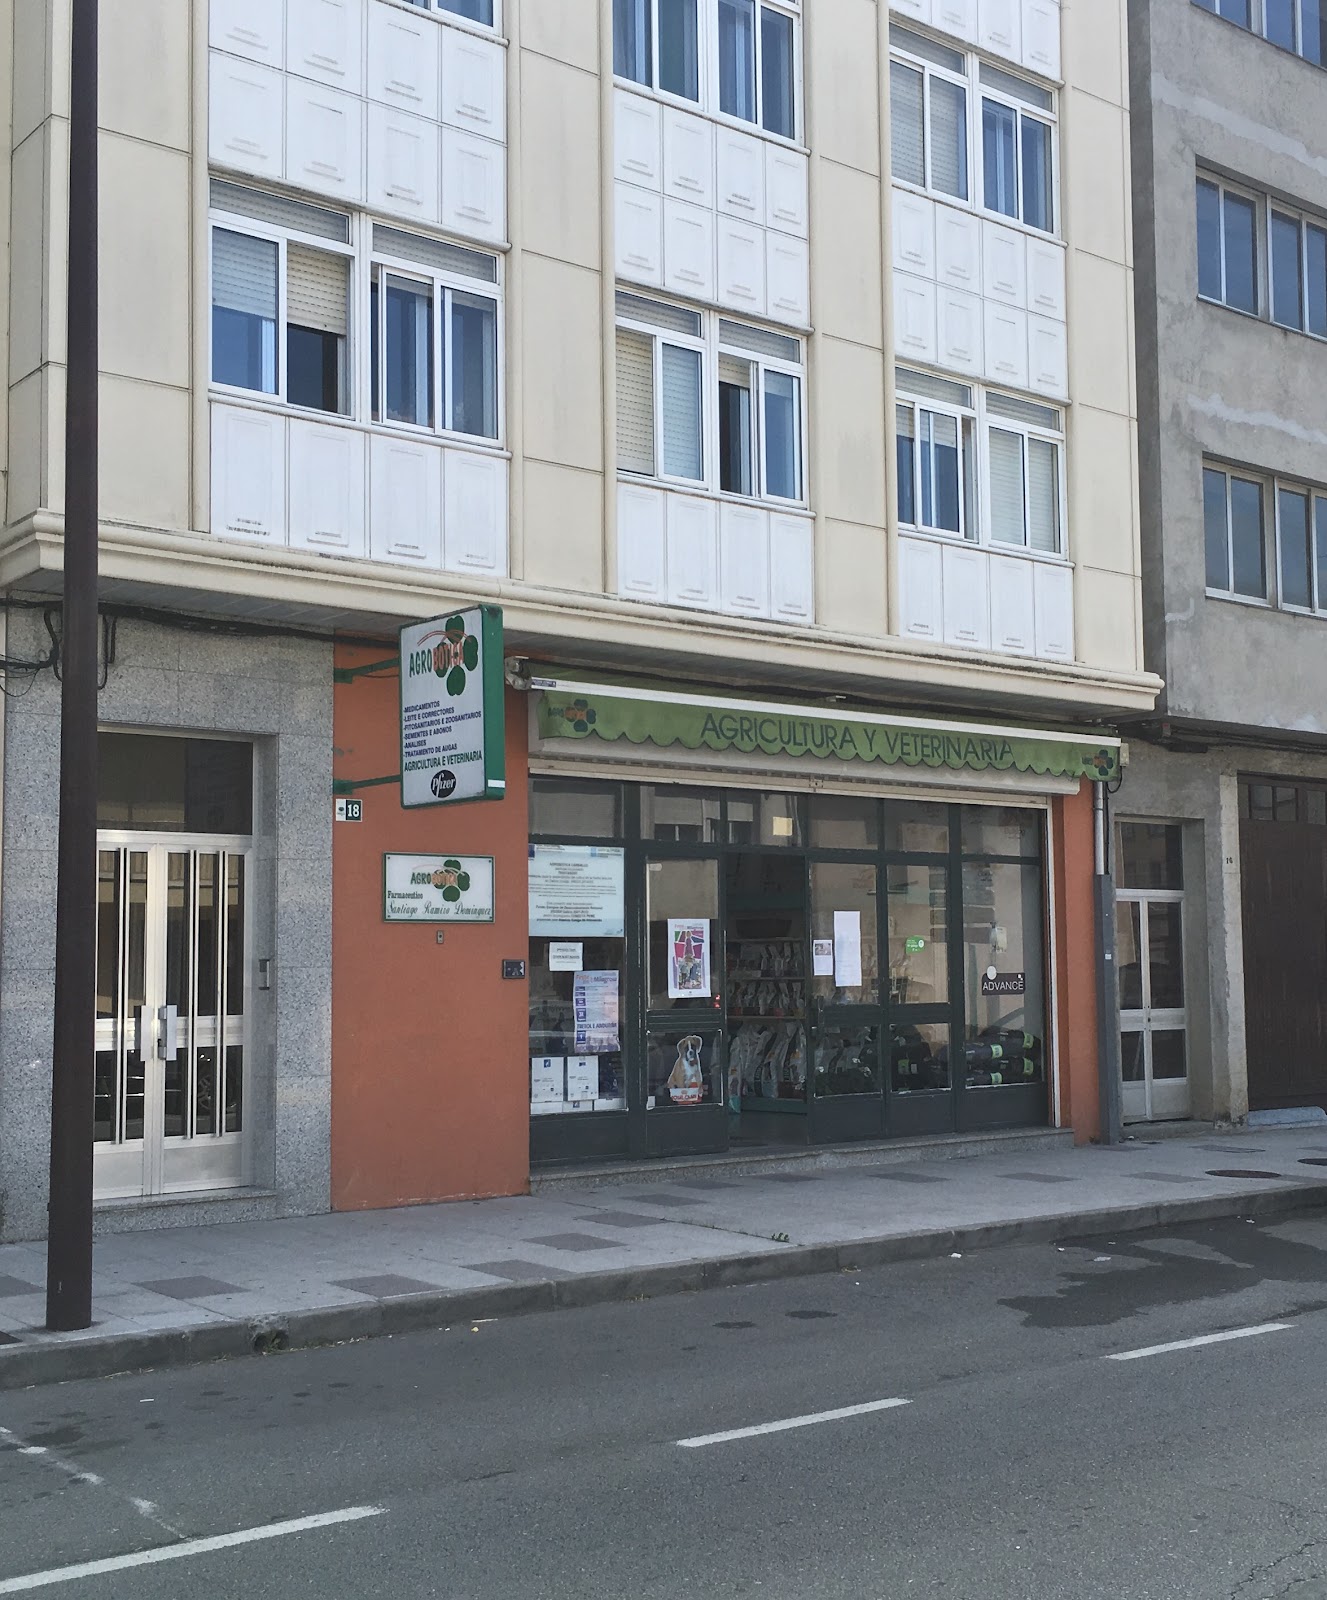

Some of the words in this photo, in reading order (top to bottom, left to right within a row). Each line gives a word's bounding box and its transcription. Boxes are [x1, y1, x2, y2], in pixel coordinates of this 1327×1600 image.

[422, 707, 455, 719] CORRECTORES
[446, 711, 482, 724] ZOOSANITARIOS
[433, 725, 453, 735] ABONOS
[701, 713, 858, 751] AGRICULTURA
[863, 728, 877, 753] Y
[885, 730, 1014, 761] VETERINARIA
[442, 743, 458, 751] AUGAS
[404, 757, 441, 772] AGRICULTURA
[442, 755, 446, 766] E
[446, 750, 483, 765] VETERINARIA
[432, 772, 456, 797] Pfizer
[347, 804, 360, 817] 18
[387, 900, 418, 917] Santiago
[421, 901, 451, 914] Ramiro
[982, 981, 1024, 991] ADVANCE
